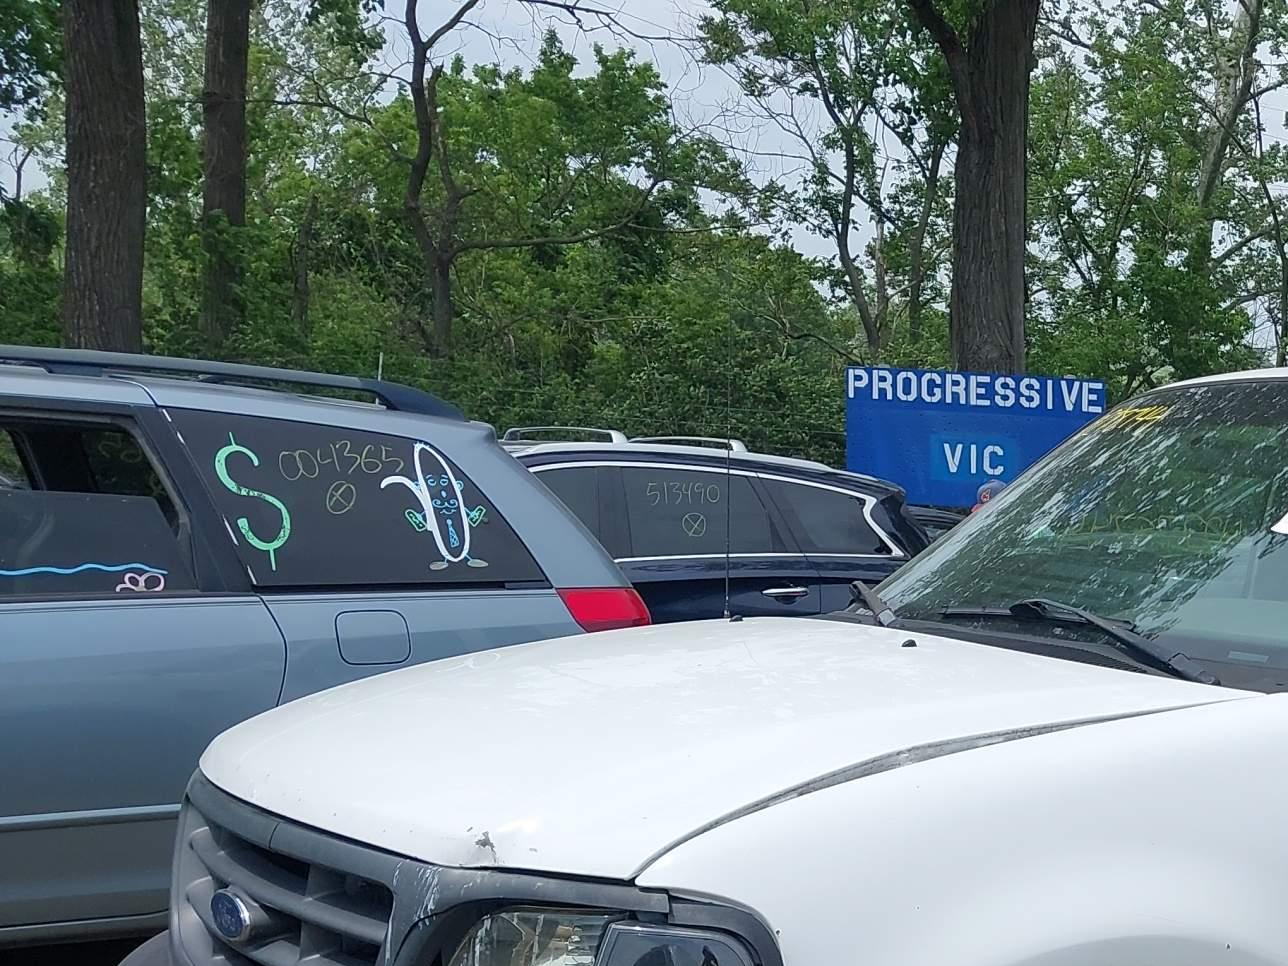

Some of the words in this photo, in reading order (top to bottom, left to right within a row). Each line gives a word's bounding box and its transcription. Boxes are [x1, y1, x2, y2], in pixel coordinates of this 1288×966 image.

[848, 368, 1104, 413] PROGRESSIVE
[278, 440, 404, 481] 004365
[943, 442, 1004, 475] VIC
[646, 481, 720, 506] 513490
